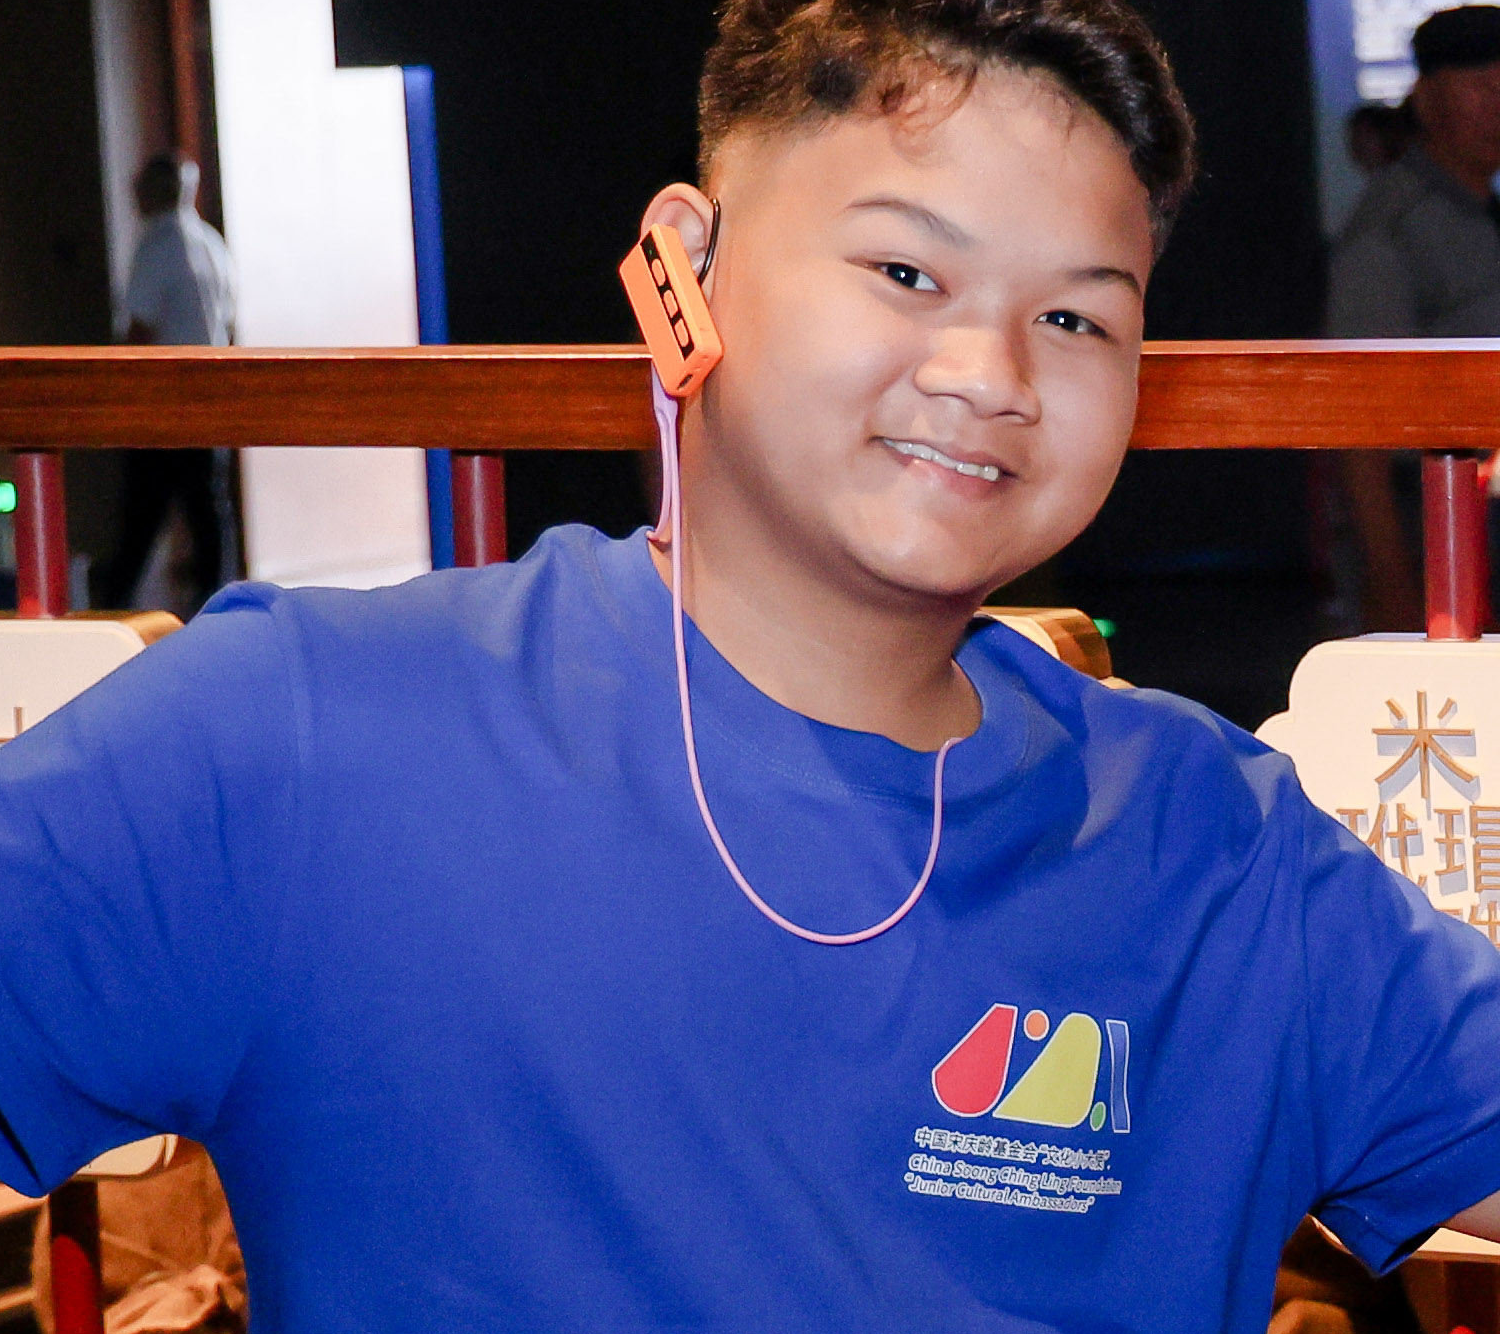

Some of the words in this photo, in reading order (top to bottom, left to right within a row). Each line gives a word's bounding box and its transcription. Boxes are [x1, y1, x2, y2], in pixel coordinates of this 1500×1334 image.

[1372, 690, 1479, 799] 米
[908, 1153, 951, 1176] China
[952, 1160, 999, 1185] Soong
[998, 1166, 1040, 1191] Ching
[1040, 1172, 1070, 1195] Ling
[955, 1182, 1010, 1206] Cultural
